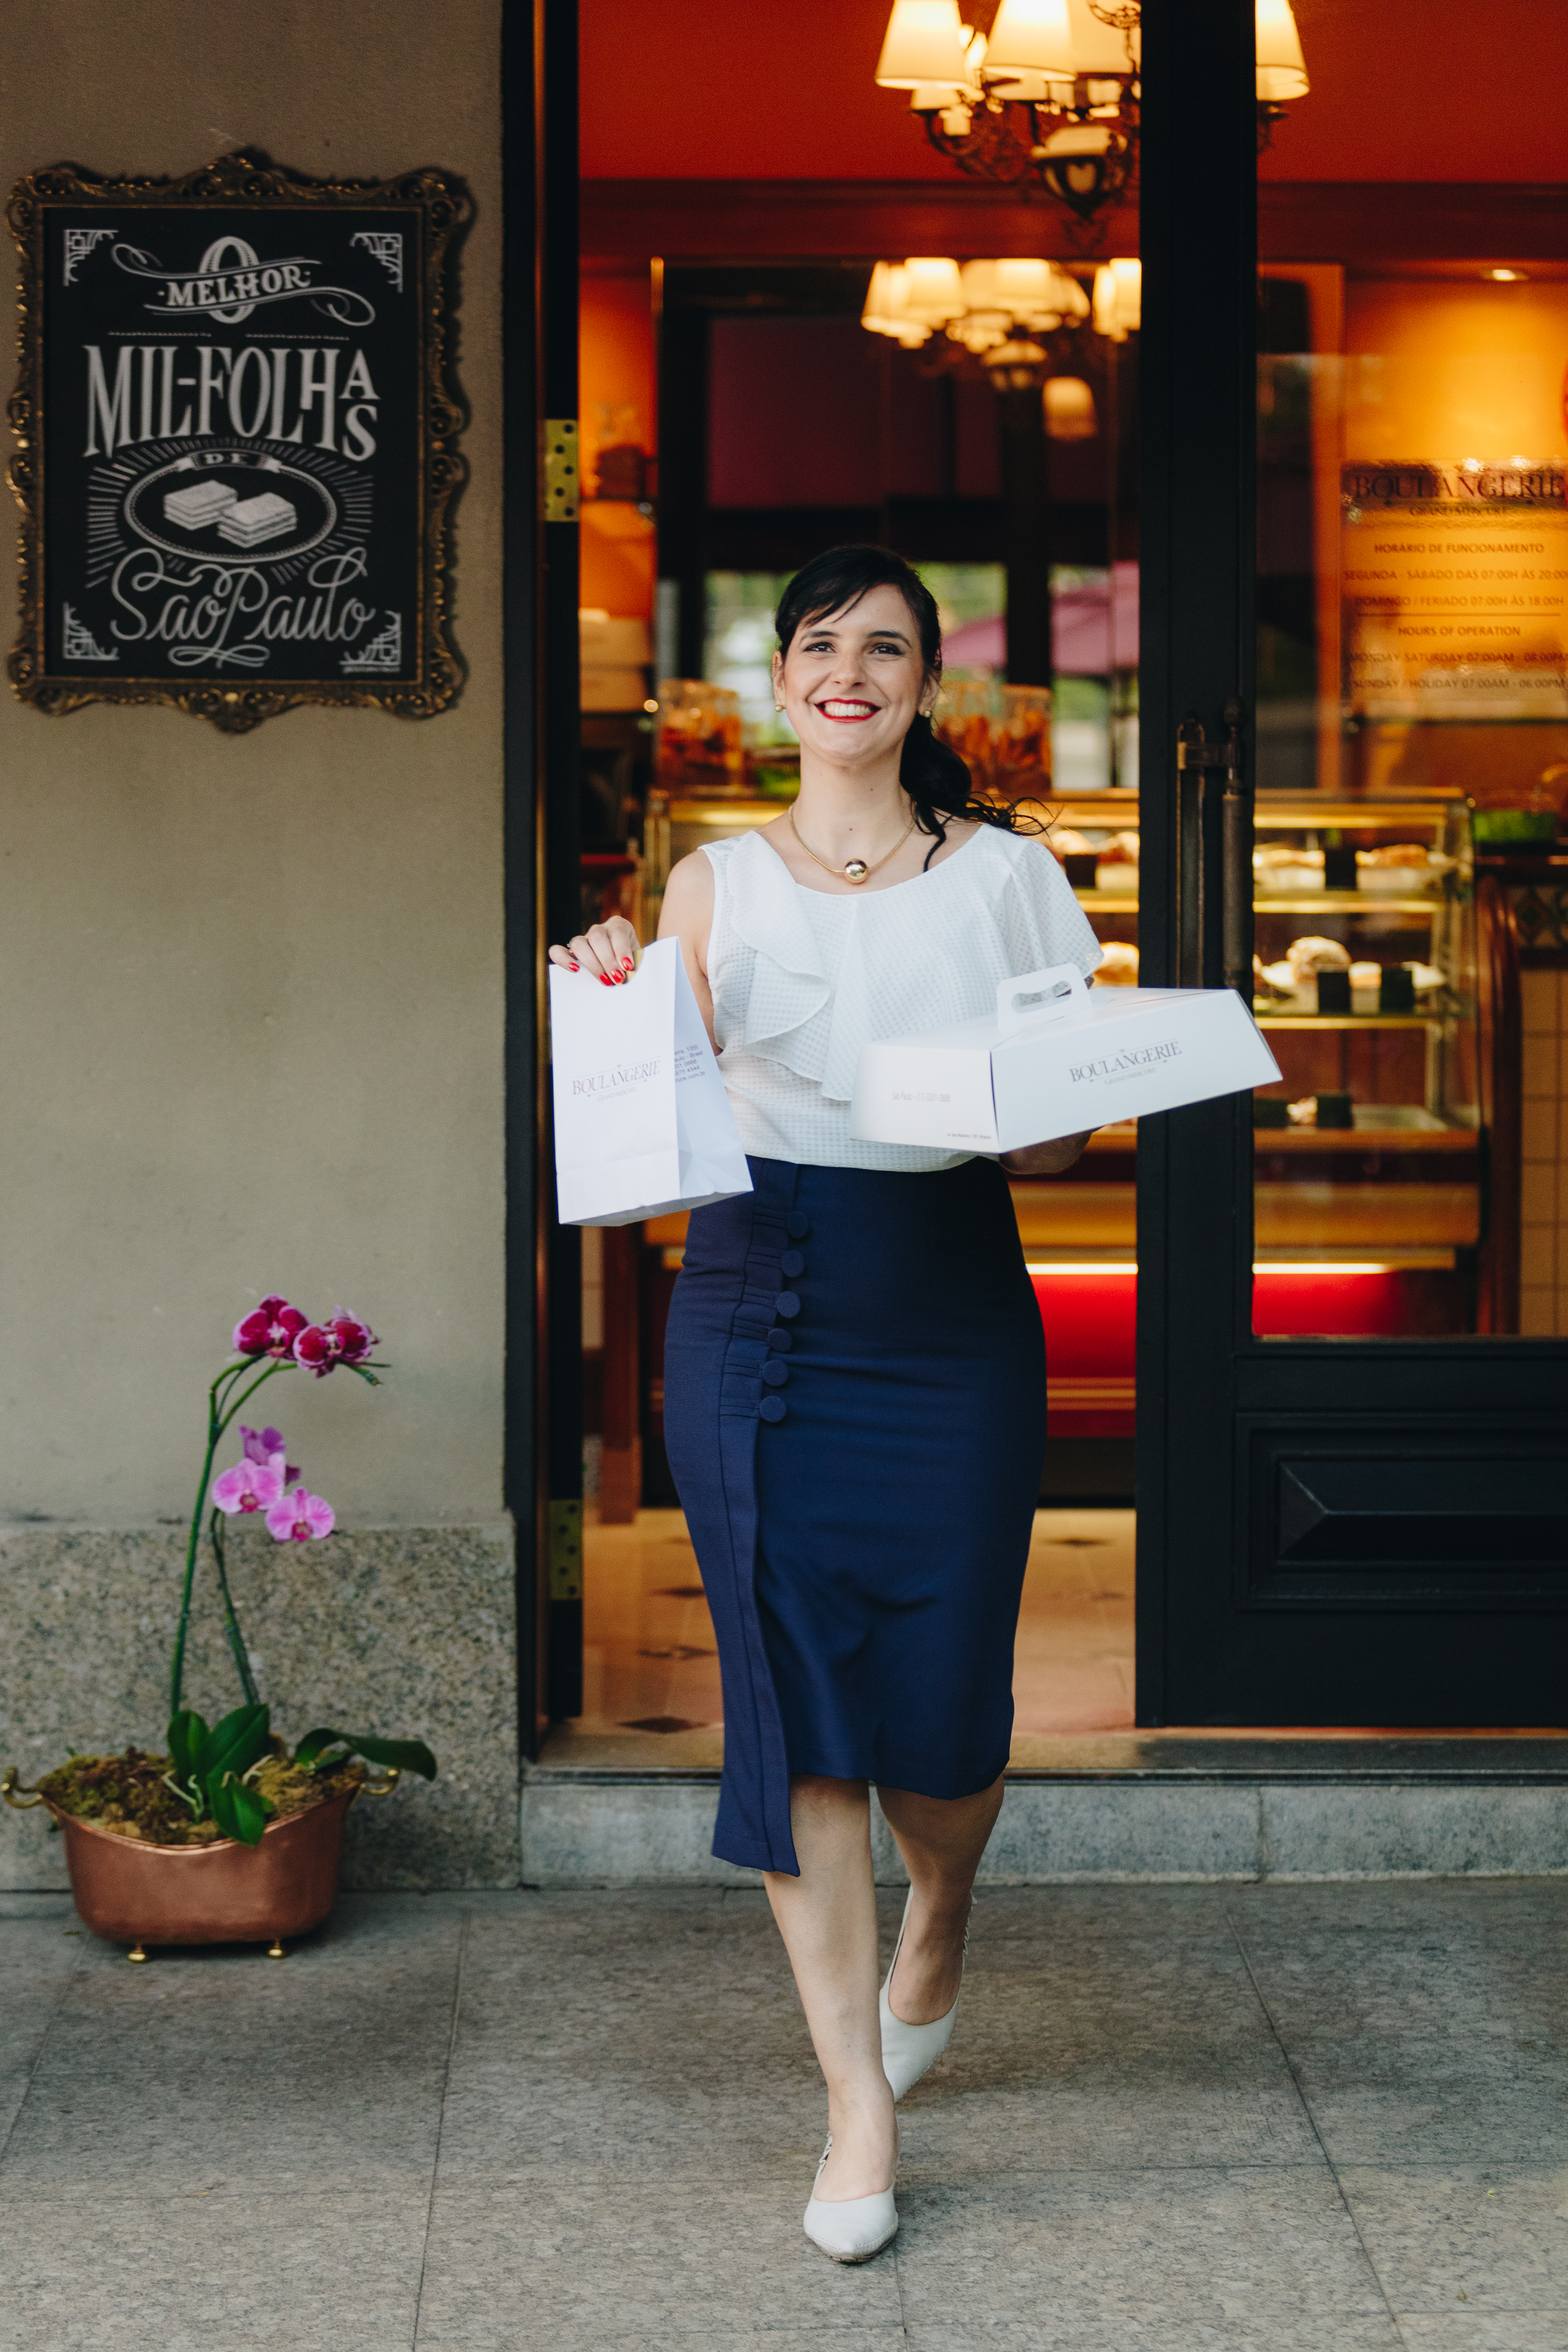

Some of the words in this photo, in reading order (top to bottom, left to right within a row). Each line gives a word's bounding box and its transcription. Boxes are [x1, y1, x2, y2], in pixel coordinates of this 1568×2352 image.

[166, 265, 311, 307] MELHOR
[205, 453, 248, 464] DE
[1429, 543, 1443, 553] DE
[1447, 542, 1545, 554] FUNCIONAMENTO
[1456, 569, 1479, 580] DAS
[1538, 569, 1568, 580] 20:00
[168, 546, 376, 668] Paulo
[1420, 596, 1468, 607] FERIADO
[1398, 626, 1437, 636] HOURS
[1439, 626, 1453, 636] OF
[1457, 626, 1521, 636] OPERATION
[1404, 652, 1463, 662] SATURDAY
[1069, 1041, 1182, 1082] BOULANGERIE
[572, 1059, 661, 1095] BOULANGERIE
[1104, 1074, 1127, 1085] GRAND
